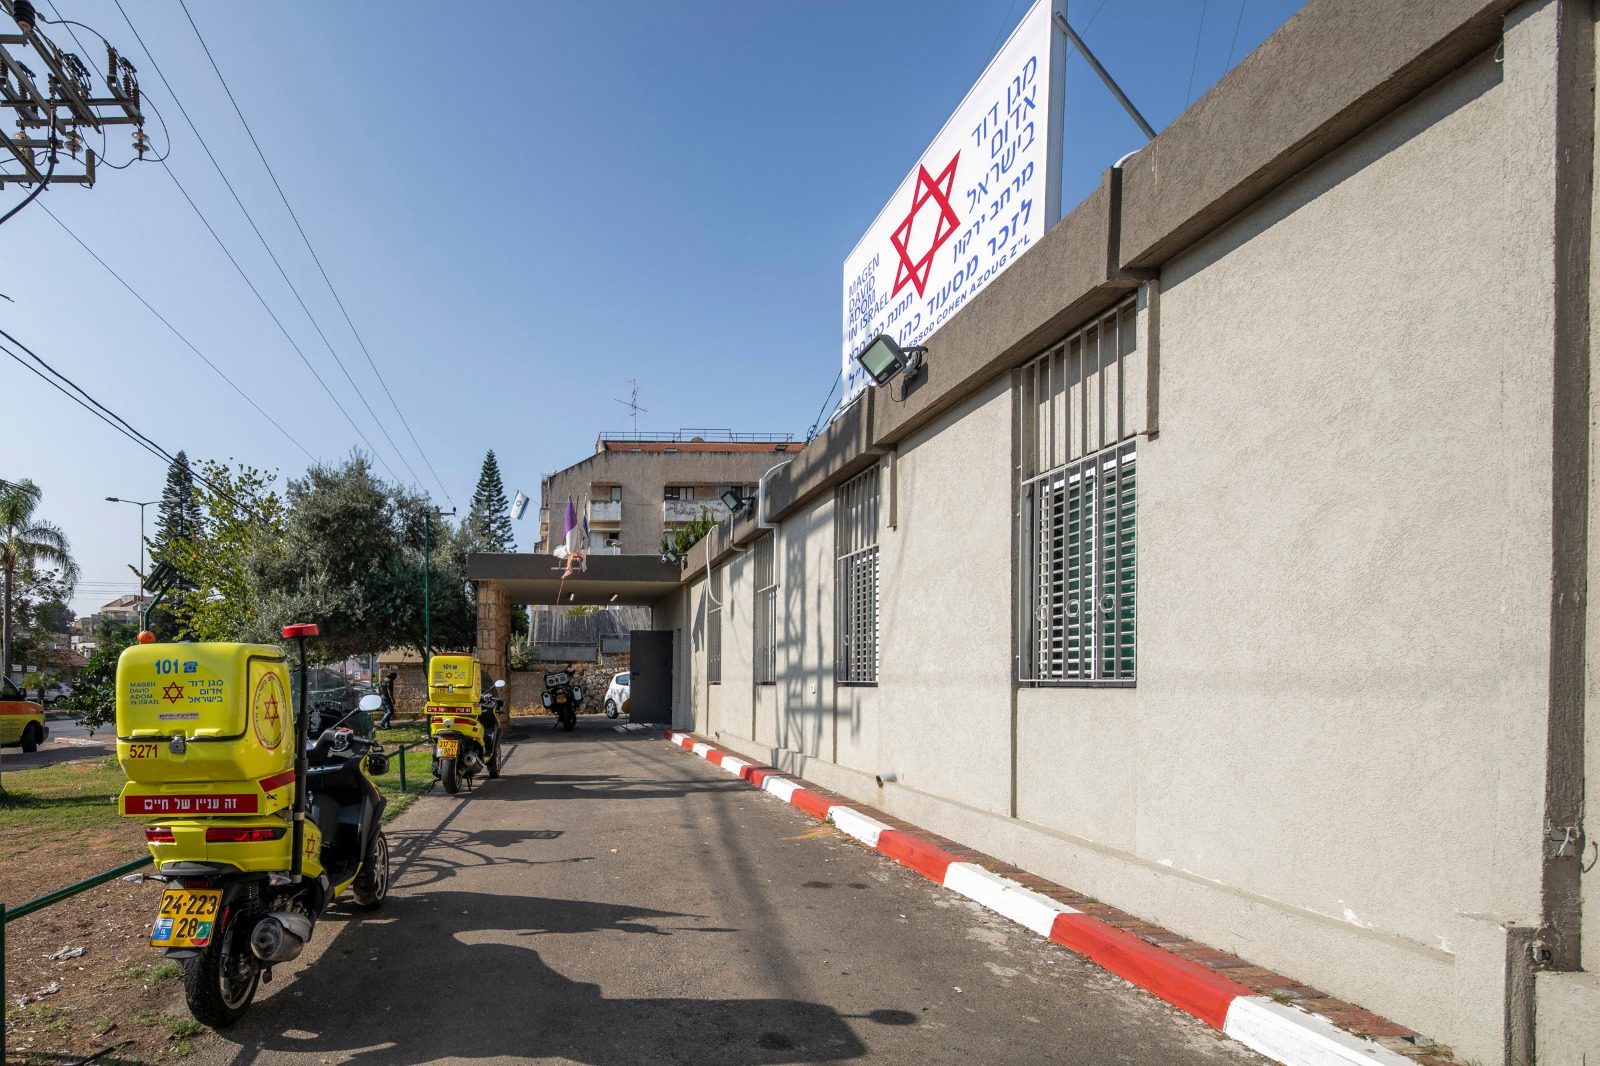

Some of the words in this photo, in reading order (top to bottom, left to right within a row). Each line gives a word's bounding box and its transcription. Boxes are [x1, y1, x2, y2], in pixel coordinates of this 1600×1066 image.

[1007, 55, 1037, 115] מגן
[971, 100, 999, 148] דוד
[991, 84, 1036, 159] אדום
[967, 121, 1035, 214] בישראל
[990, 161, 1034, 221] מרחב
[953, 213, 985, 264] ירקון
[987, 198, 1032, 256] לזכר
[849, 252, 880, 298] MAGEN
[849, 275, 875, 313] DAVID
[927, 254, 979, 316] מסעוד
[848, 322, 858, 342] IN
[860, 291, 890, 331] ISRAEL
[849, 288, 876, 328] ADOM
[886, 292, 913, 328] תחנת
[906, 321, 935, 347] ESSOD
[936, 290, 967, 324] COHEN
[969, 254, 1007, 295] AZOUG
[898, 312, 921, 347] כהן
[155, 659, 179, 675] 101
[208, 679, 224, 688] מגן
[187, 695, 224, 704] בישראל
[129, 744, 158, 759] 5271
[144, 798, 169, 810] חיים
[174, 797, 191, 810] של
[195, 798, 220, 811] עניין
[224, 798, 237, 809] זה
[175, 917, 199, 938] 28
